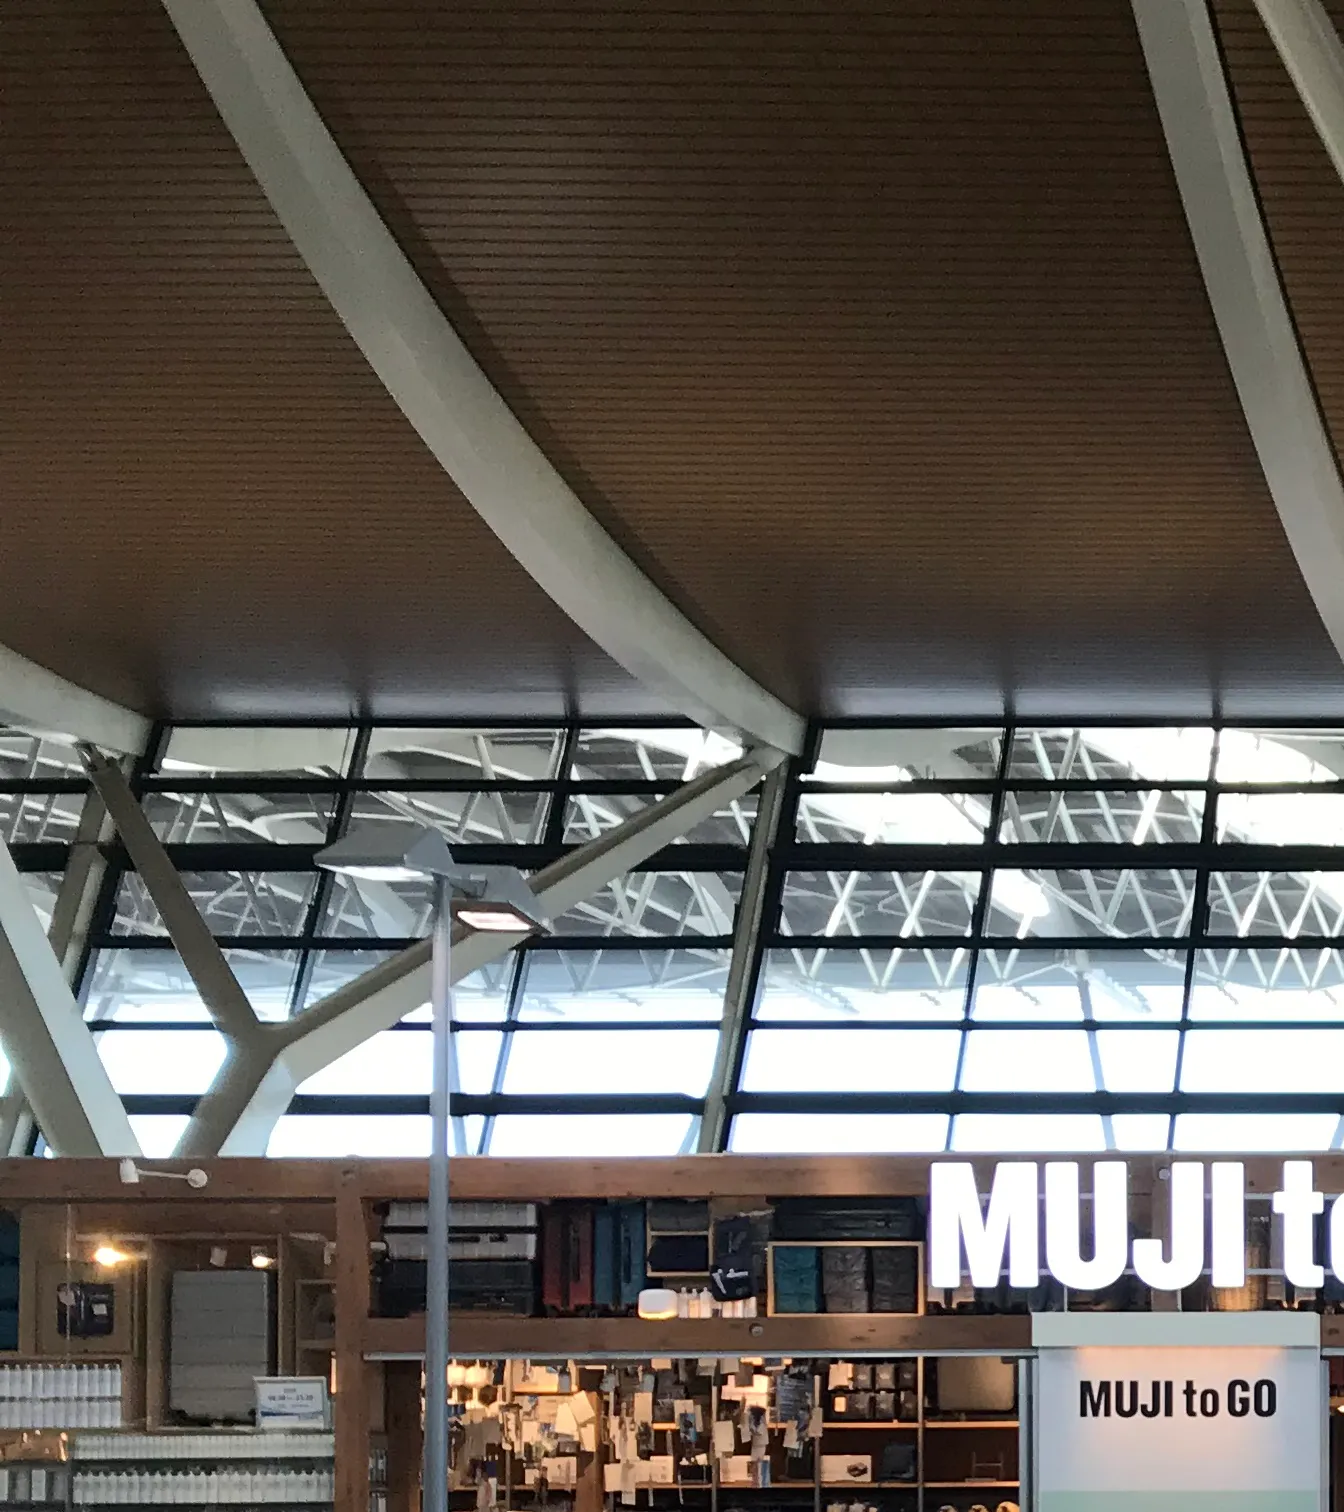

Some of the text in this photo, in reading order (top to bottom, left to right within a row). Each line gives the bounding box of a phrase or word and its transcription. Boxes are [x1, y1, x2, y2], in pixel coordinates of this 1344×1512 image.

[929, 1160, 1245, 1290] MUJI
[1079, 1378, 1277, 1418] MUJI to GO
